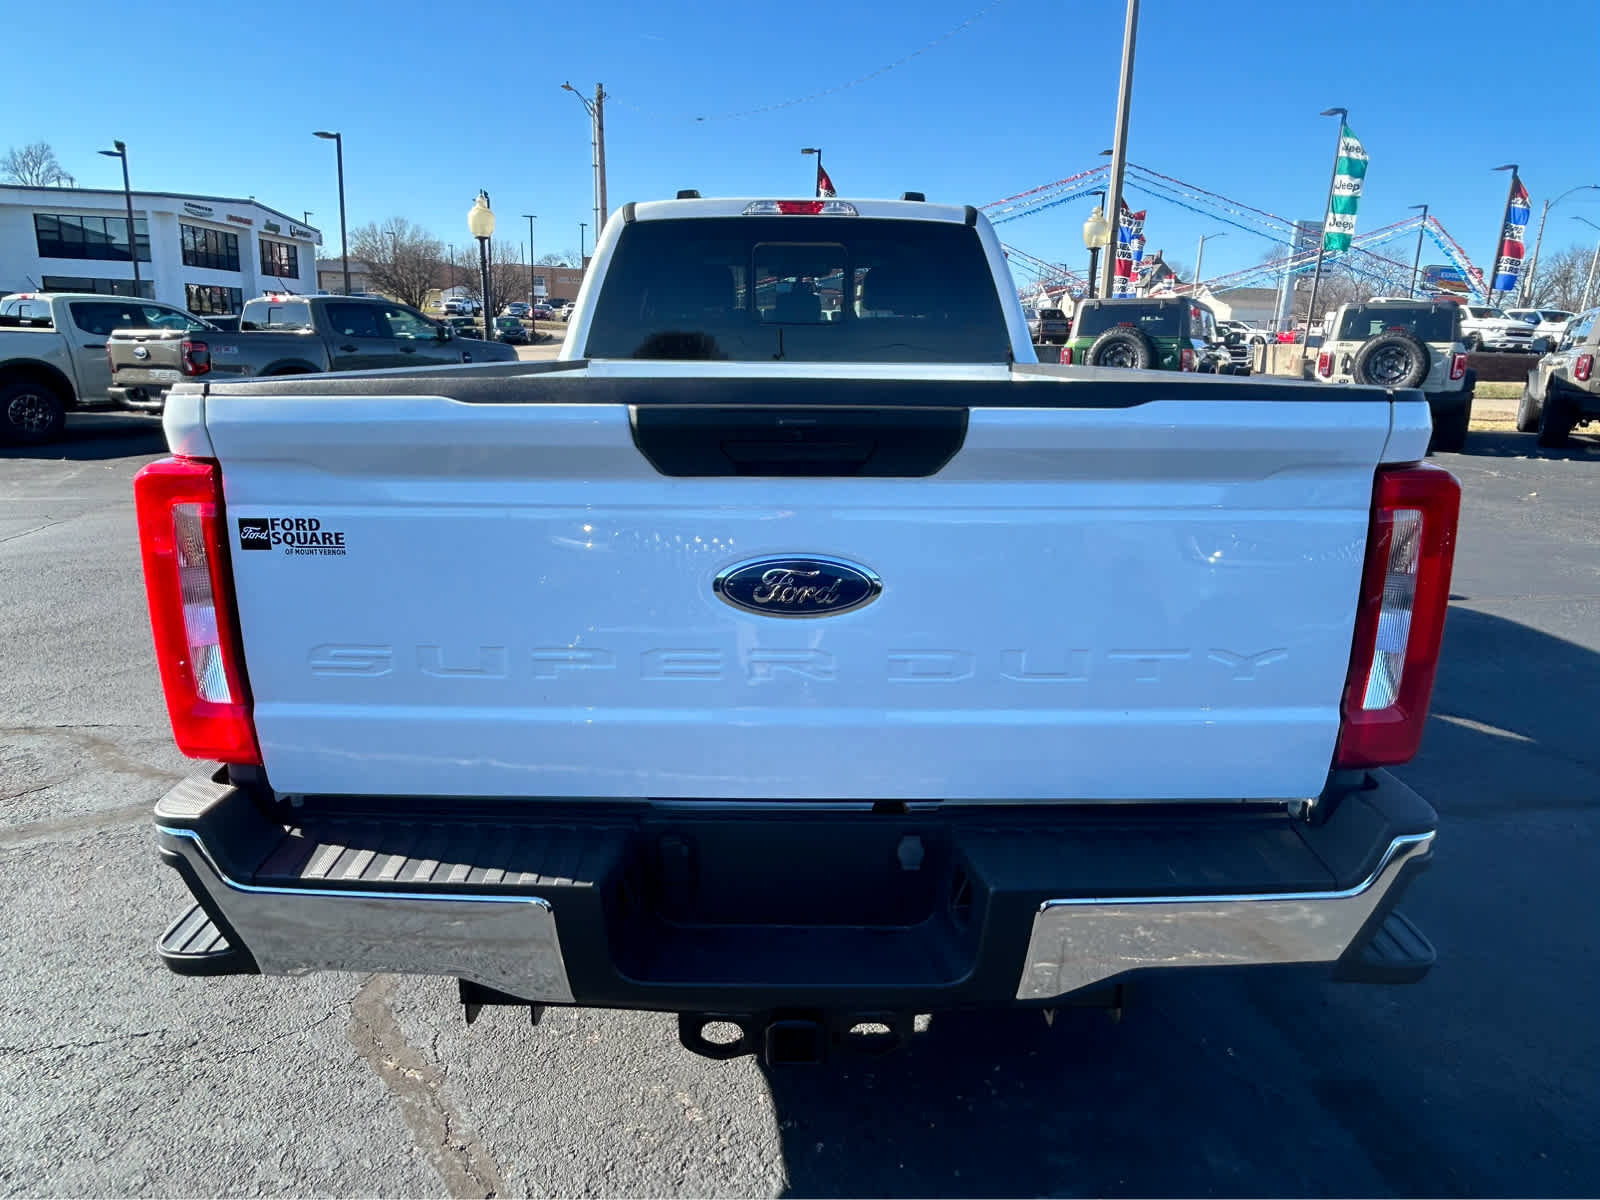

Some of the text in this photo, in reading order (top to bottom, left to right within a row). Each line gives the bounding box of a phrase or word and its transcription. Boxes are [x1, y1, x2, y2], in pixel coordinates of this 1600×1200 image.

[1335, 180, 1360, 192] Jeep
[1329, 218, 1354, 230] Jeep
[270, 518, 320, 531] FORD
[240, 526, 269, 540] Ford
[271, 532, 345, 547] SQUARE
[752, 567, 841, 604] Ford
[307, 642, 1289, 682] SUPER DUTY
